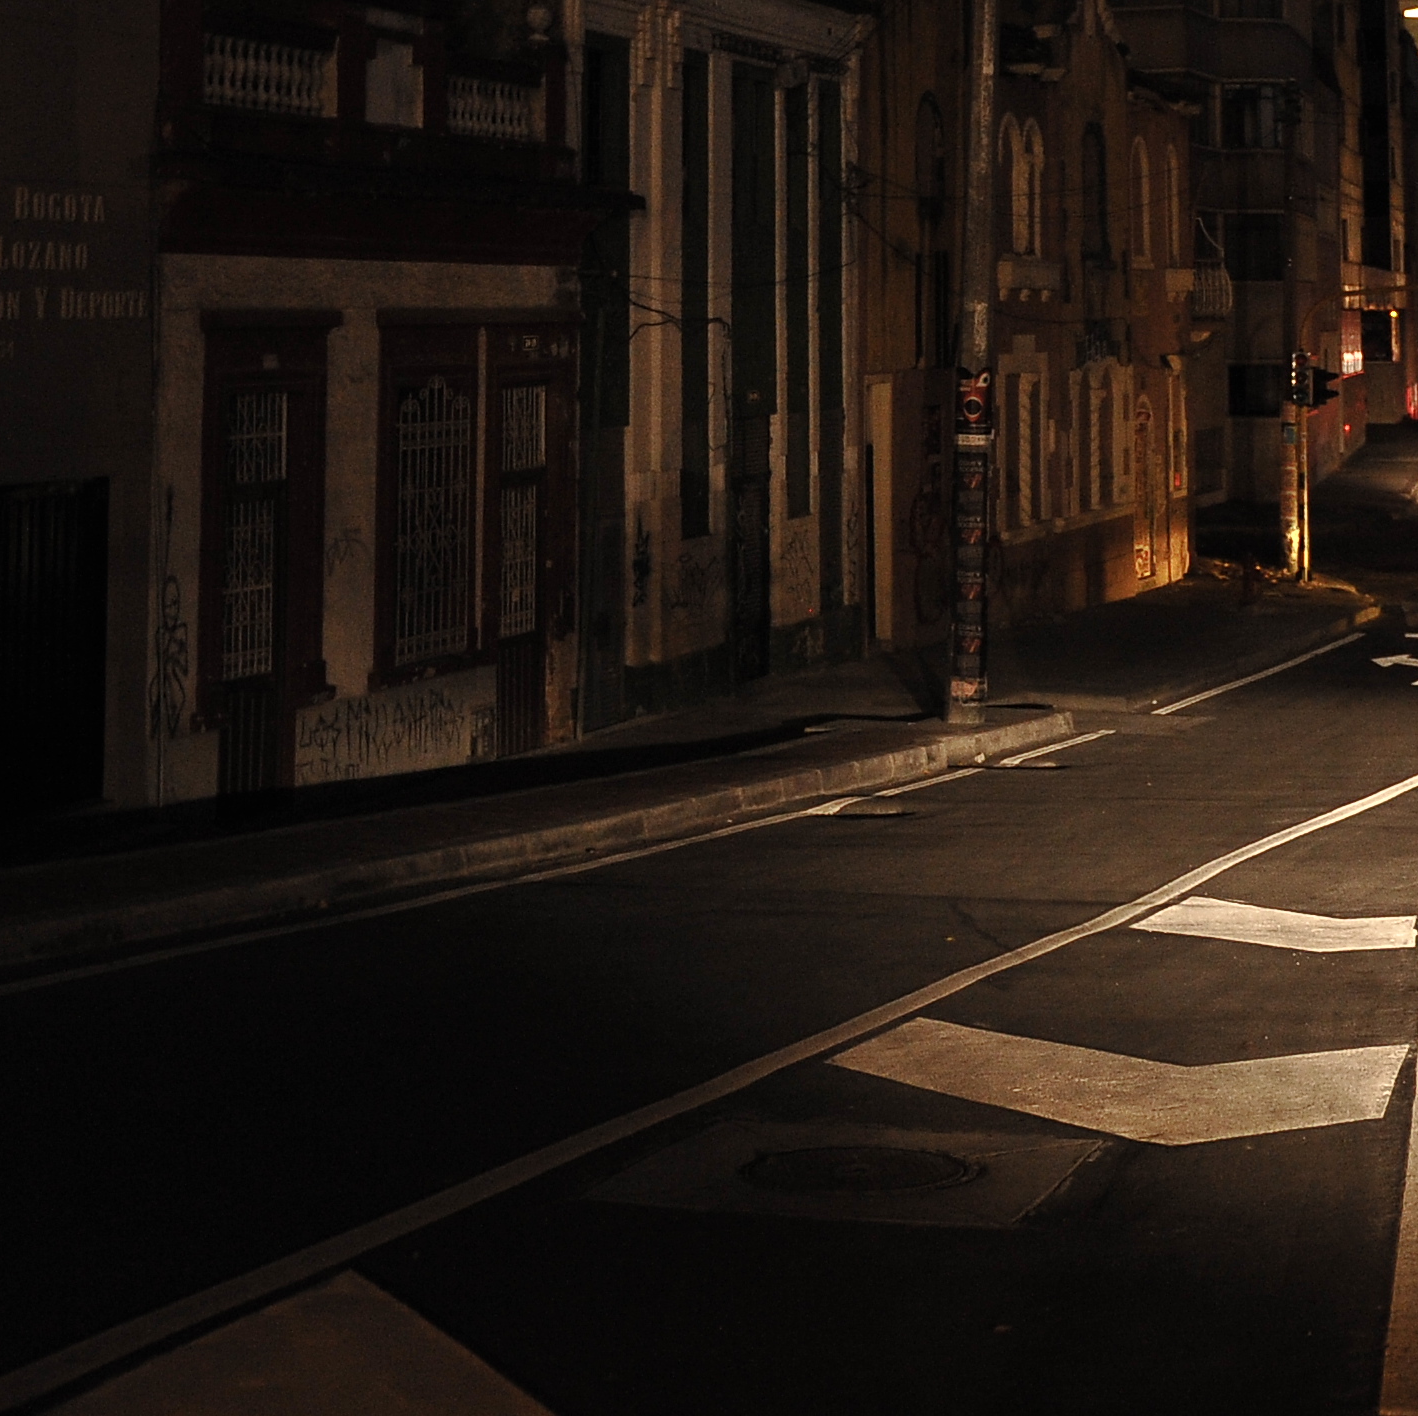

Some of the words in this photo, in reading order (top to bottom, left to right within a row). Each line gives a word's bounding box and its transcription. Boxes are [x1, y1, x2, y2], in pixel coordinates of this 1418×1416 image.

[15, 186, 106, 223] BOGOTA
[34, 286, 50, 319] Y
[60, 286, 149, 319] DEPORTE
